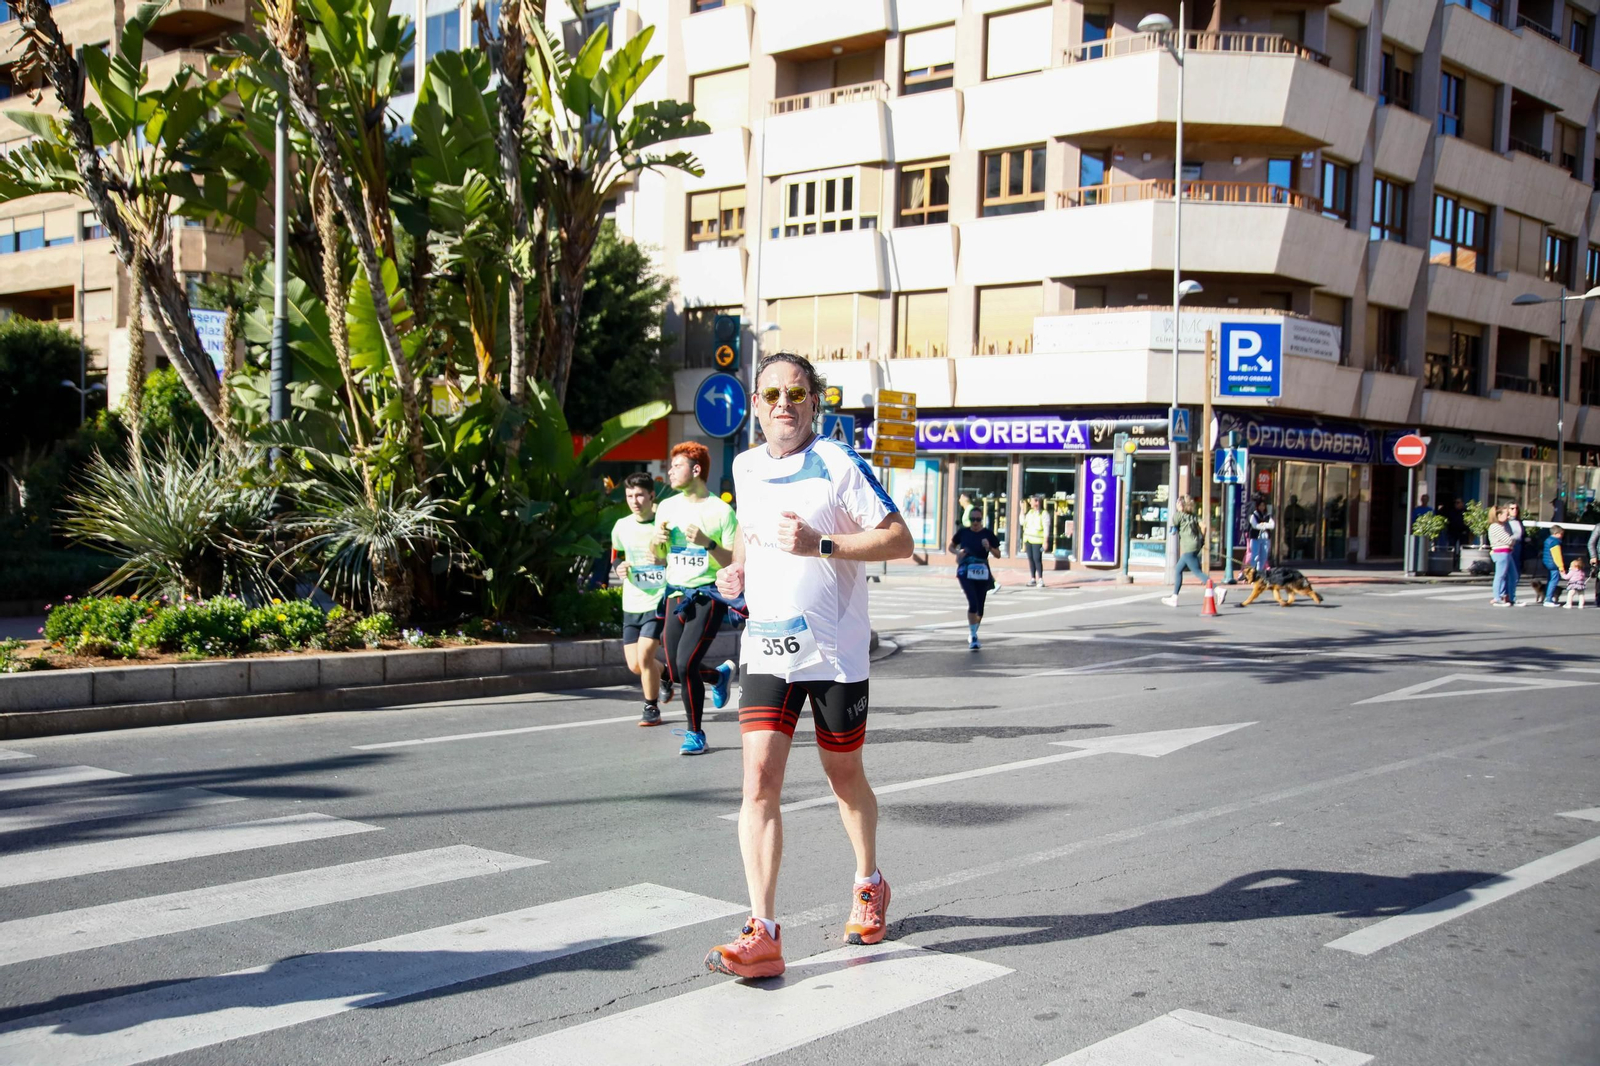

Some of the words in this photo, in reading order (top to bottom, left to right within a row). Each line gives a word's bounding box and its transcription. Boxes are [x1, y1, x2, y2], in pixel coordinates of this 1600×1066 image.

[1229, 329, 1262, 372] P
[1132, 425, 1145, 435] DE
[1090, 478, 1107, 560] OPTICA
[674, 555, 705, 567] 1145
[634, 571, 663, 582] 1146
[761, 636, 801, 656] 356
